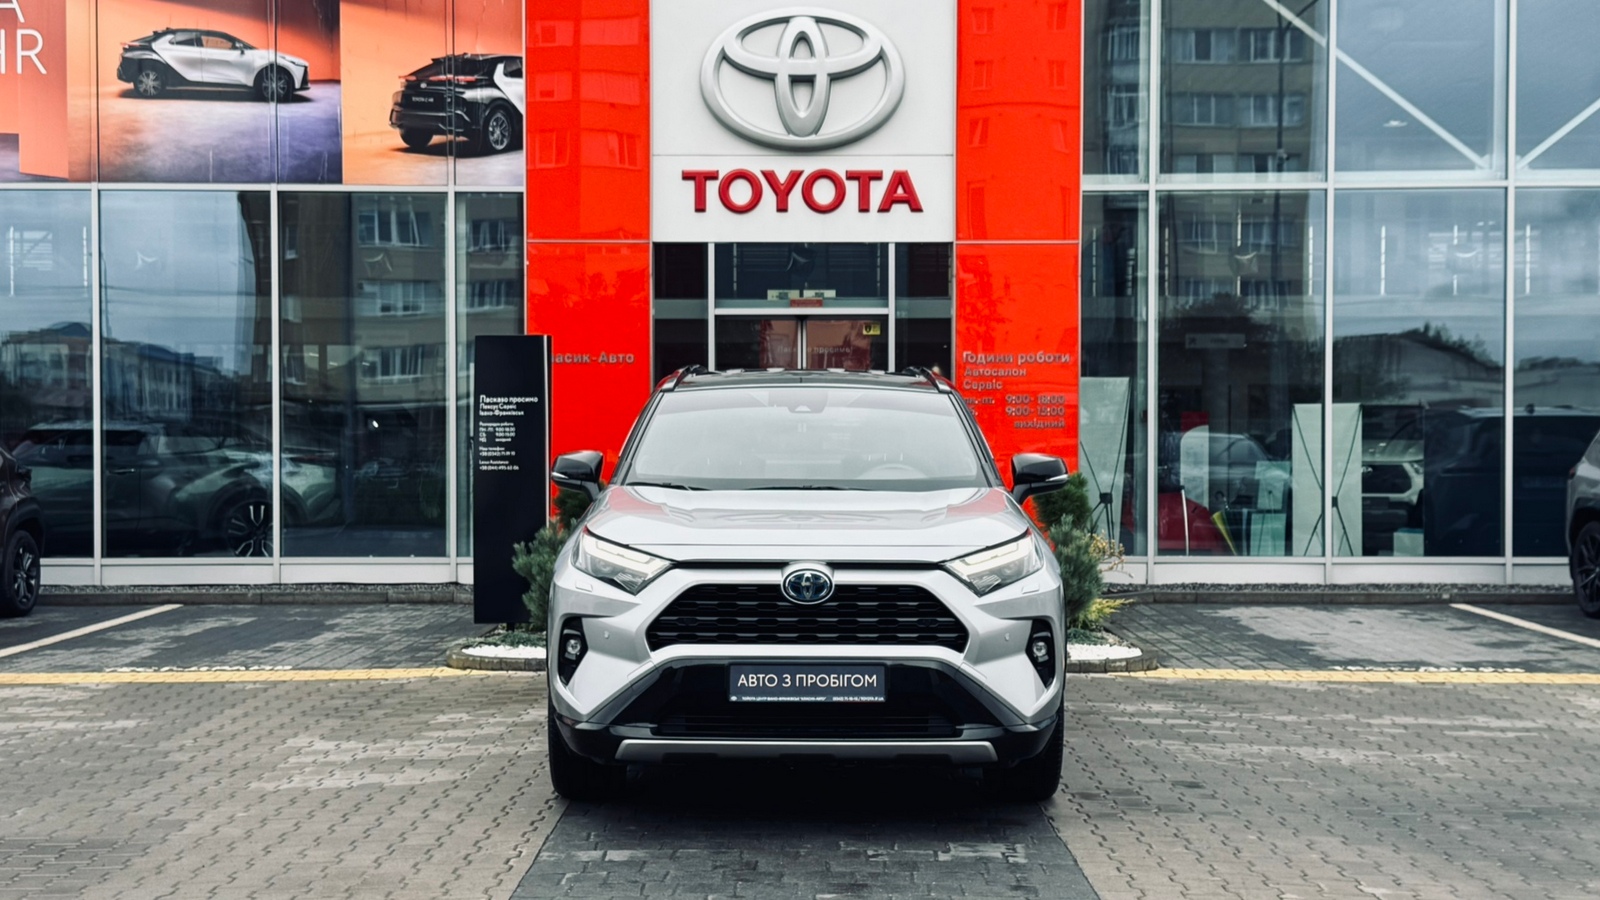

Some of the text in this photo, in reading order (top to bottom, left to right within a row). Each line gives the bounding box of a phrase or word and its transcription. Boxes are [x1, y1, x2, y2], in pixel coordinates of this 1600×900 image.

[681, 168, 924, 215] TOYOTA
[551, 351, 635, 364] асик-Авто
[963, 350, 1070, 365] Години роботи
[964, 367, 1027, 377] Автосалон
[963, 379, 1003, 391] Сервіс
[509, 396, 539, 404] просимо
[737, 673, 877, 688] АВТО З ПРОБІГОМ
